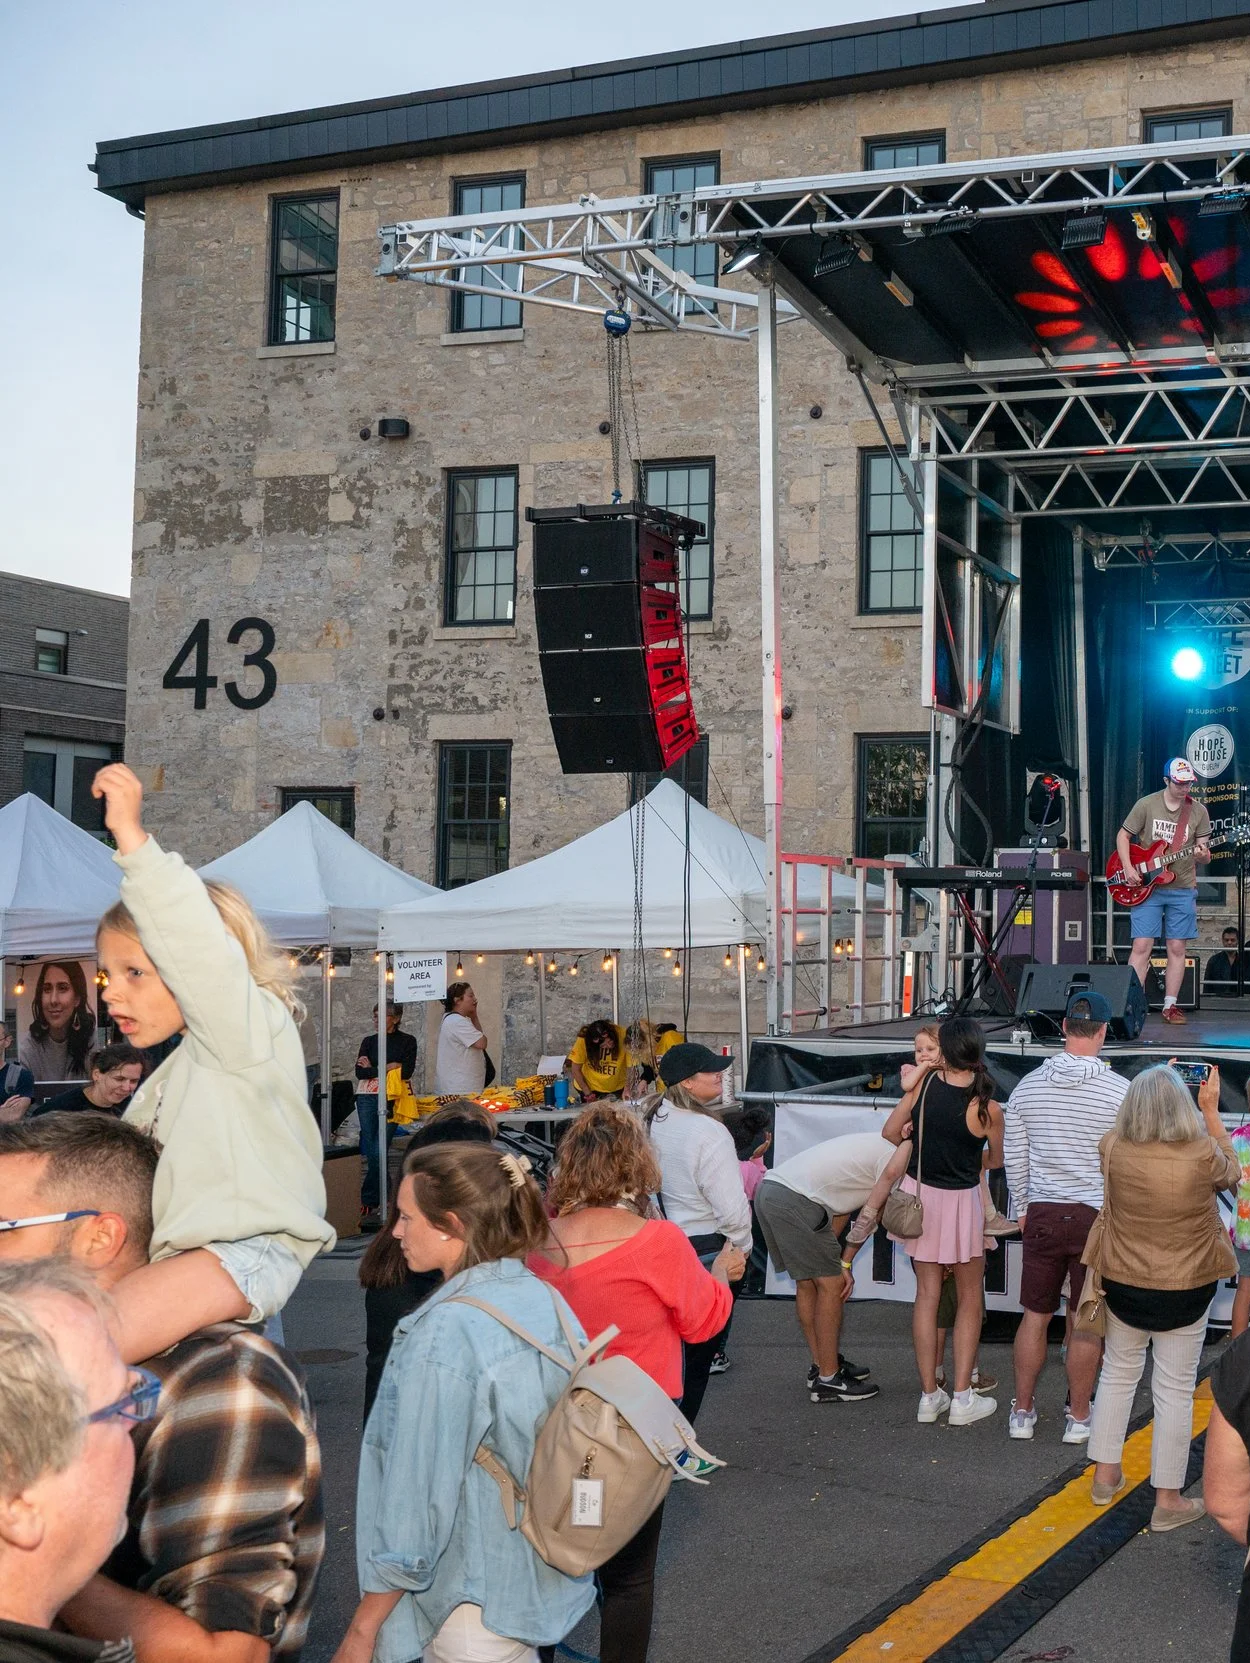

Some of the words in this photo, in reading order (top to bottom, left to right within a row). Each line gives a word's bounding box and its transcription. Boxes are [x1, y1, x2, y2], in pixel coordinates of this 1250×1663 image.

[162, 616, 277, 711] 43
[1195, 707, 1225, 715] SUPPORT
[1198, 737, 1225, 751] HOPE
[1194, 747, 1228, 762] HOUSE
[1226, 783, 1240, 791] OU
[1203, 793, 1240, 804] SPONSORS
[975, 870, 1003, 878] Roland
[397, 958, 443, 970] VOLUNTEER
[409, 971, 431, 981] AREA
